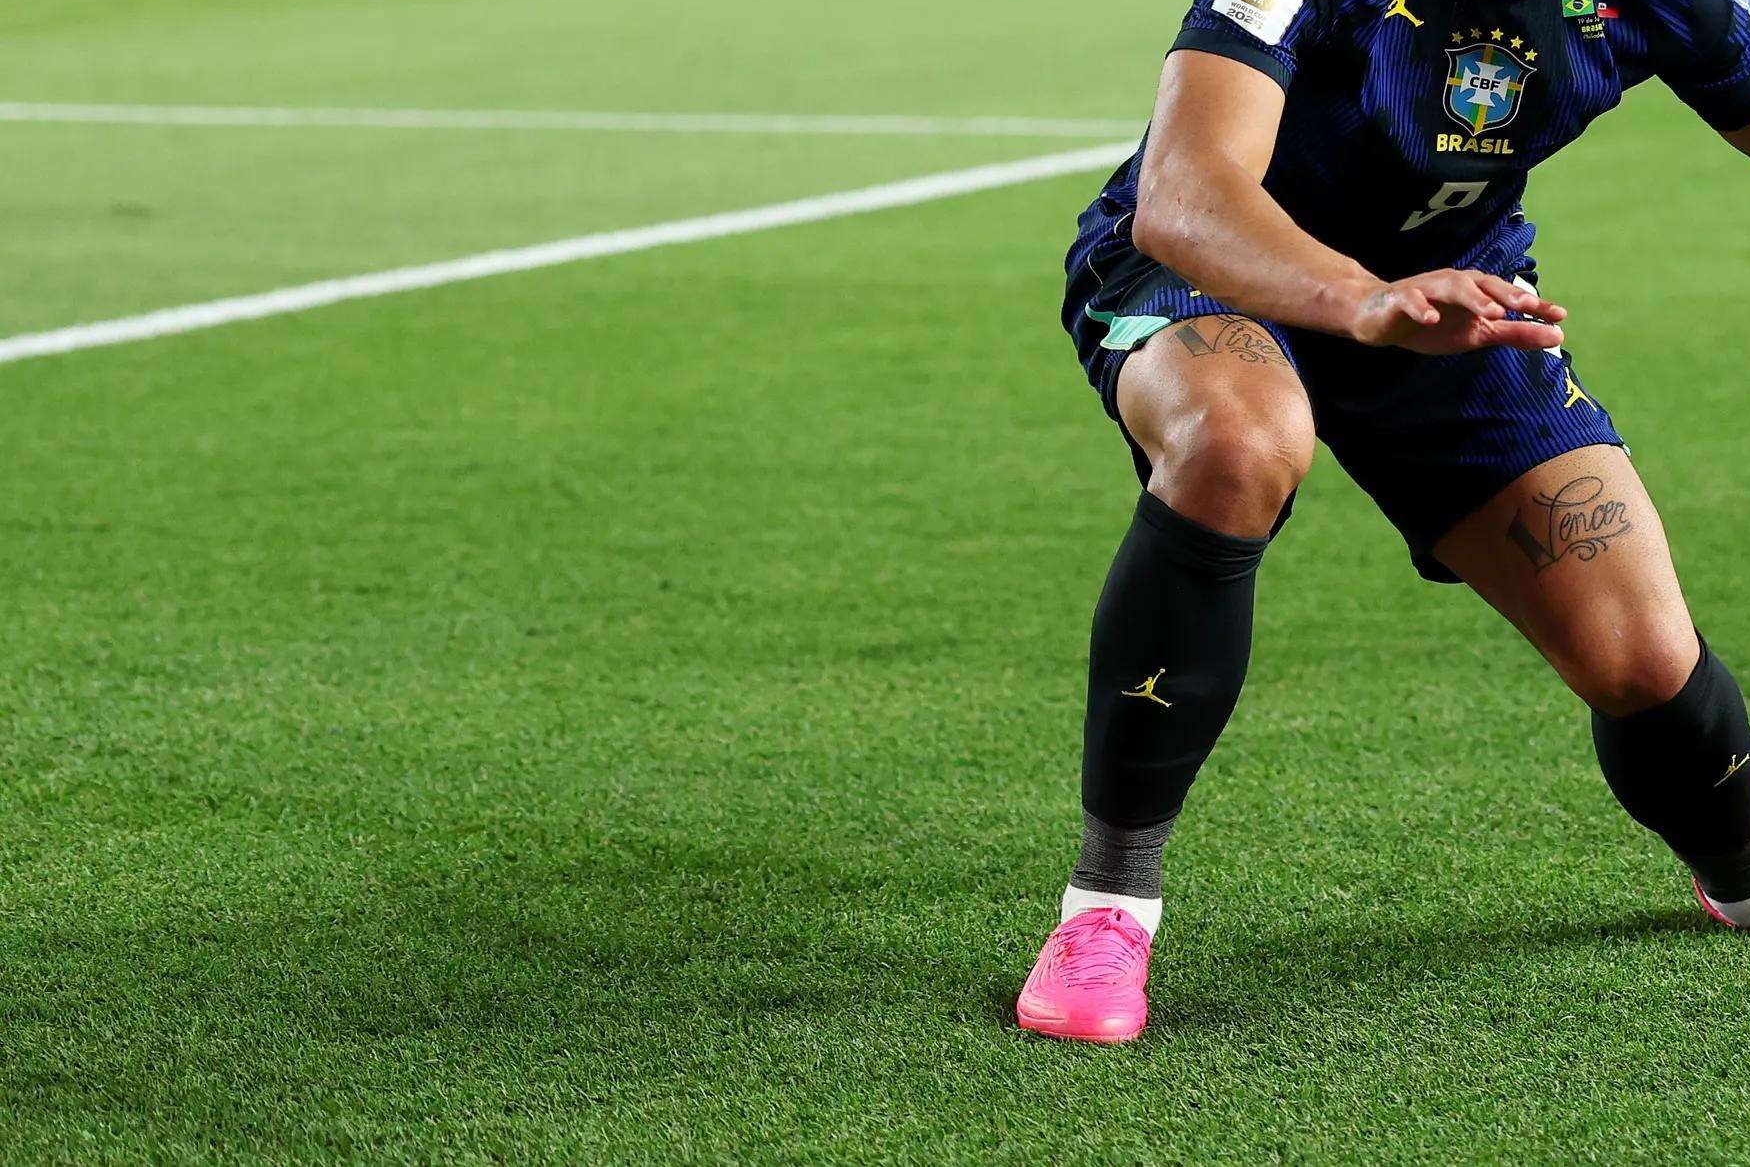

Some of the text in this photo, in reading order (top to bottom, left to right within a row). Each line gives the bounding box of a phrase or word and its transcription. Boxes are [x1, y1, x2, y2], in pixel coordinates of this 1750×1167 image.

[1231, 2, 1254, 14] WORLD
[1469, 76, 1501, 92] CBF
[1436, 134, 1514, 154] BRASIL
[1400, 181, 1489, 232] 9
